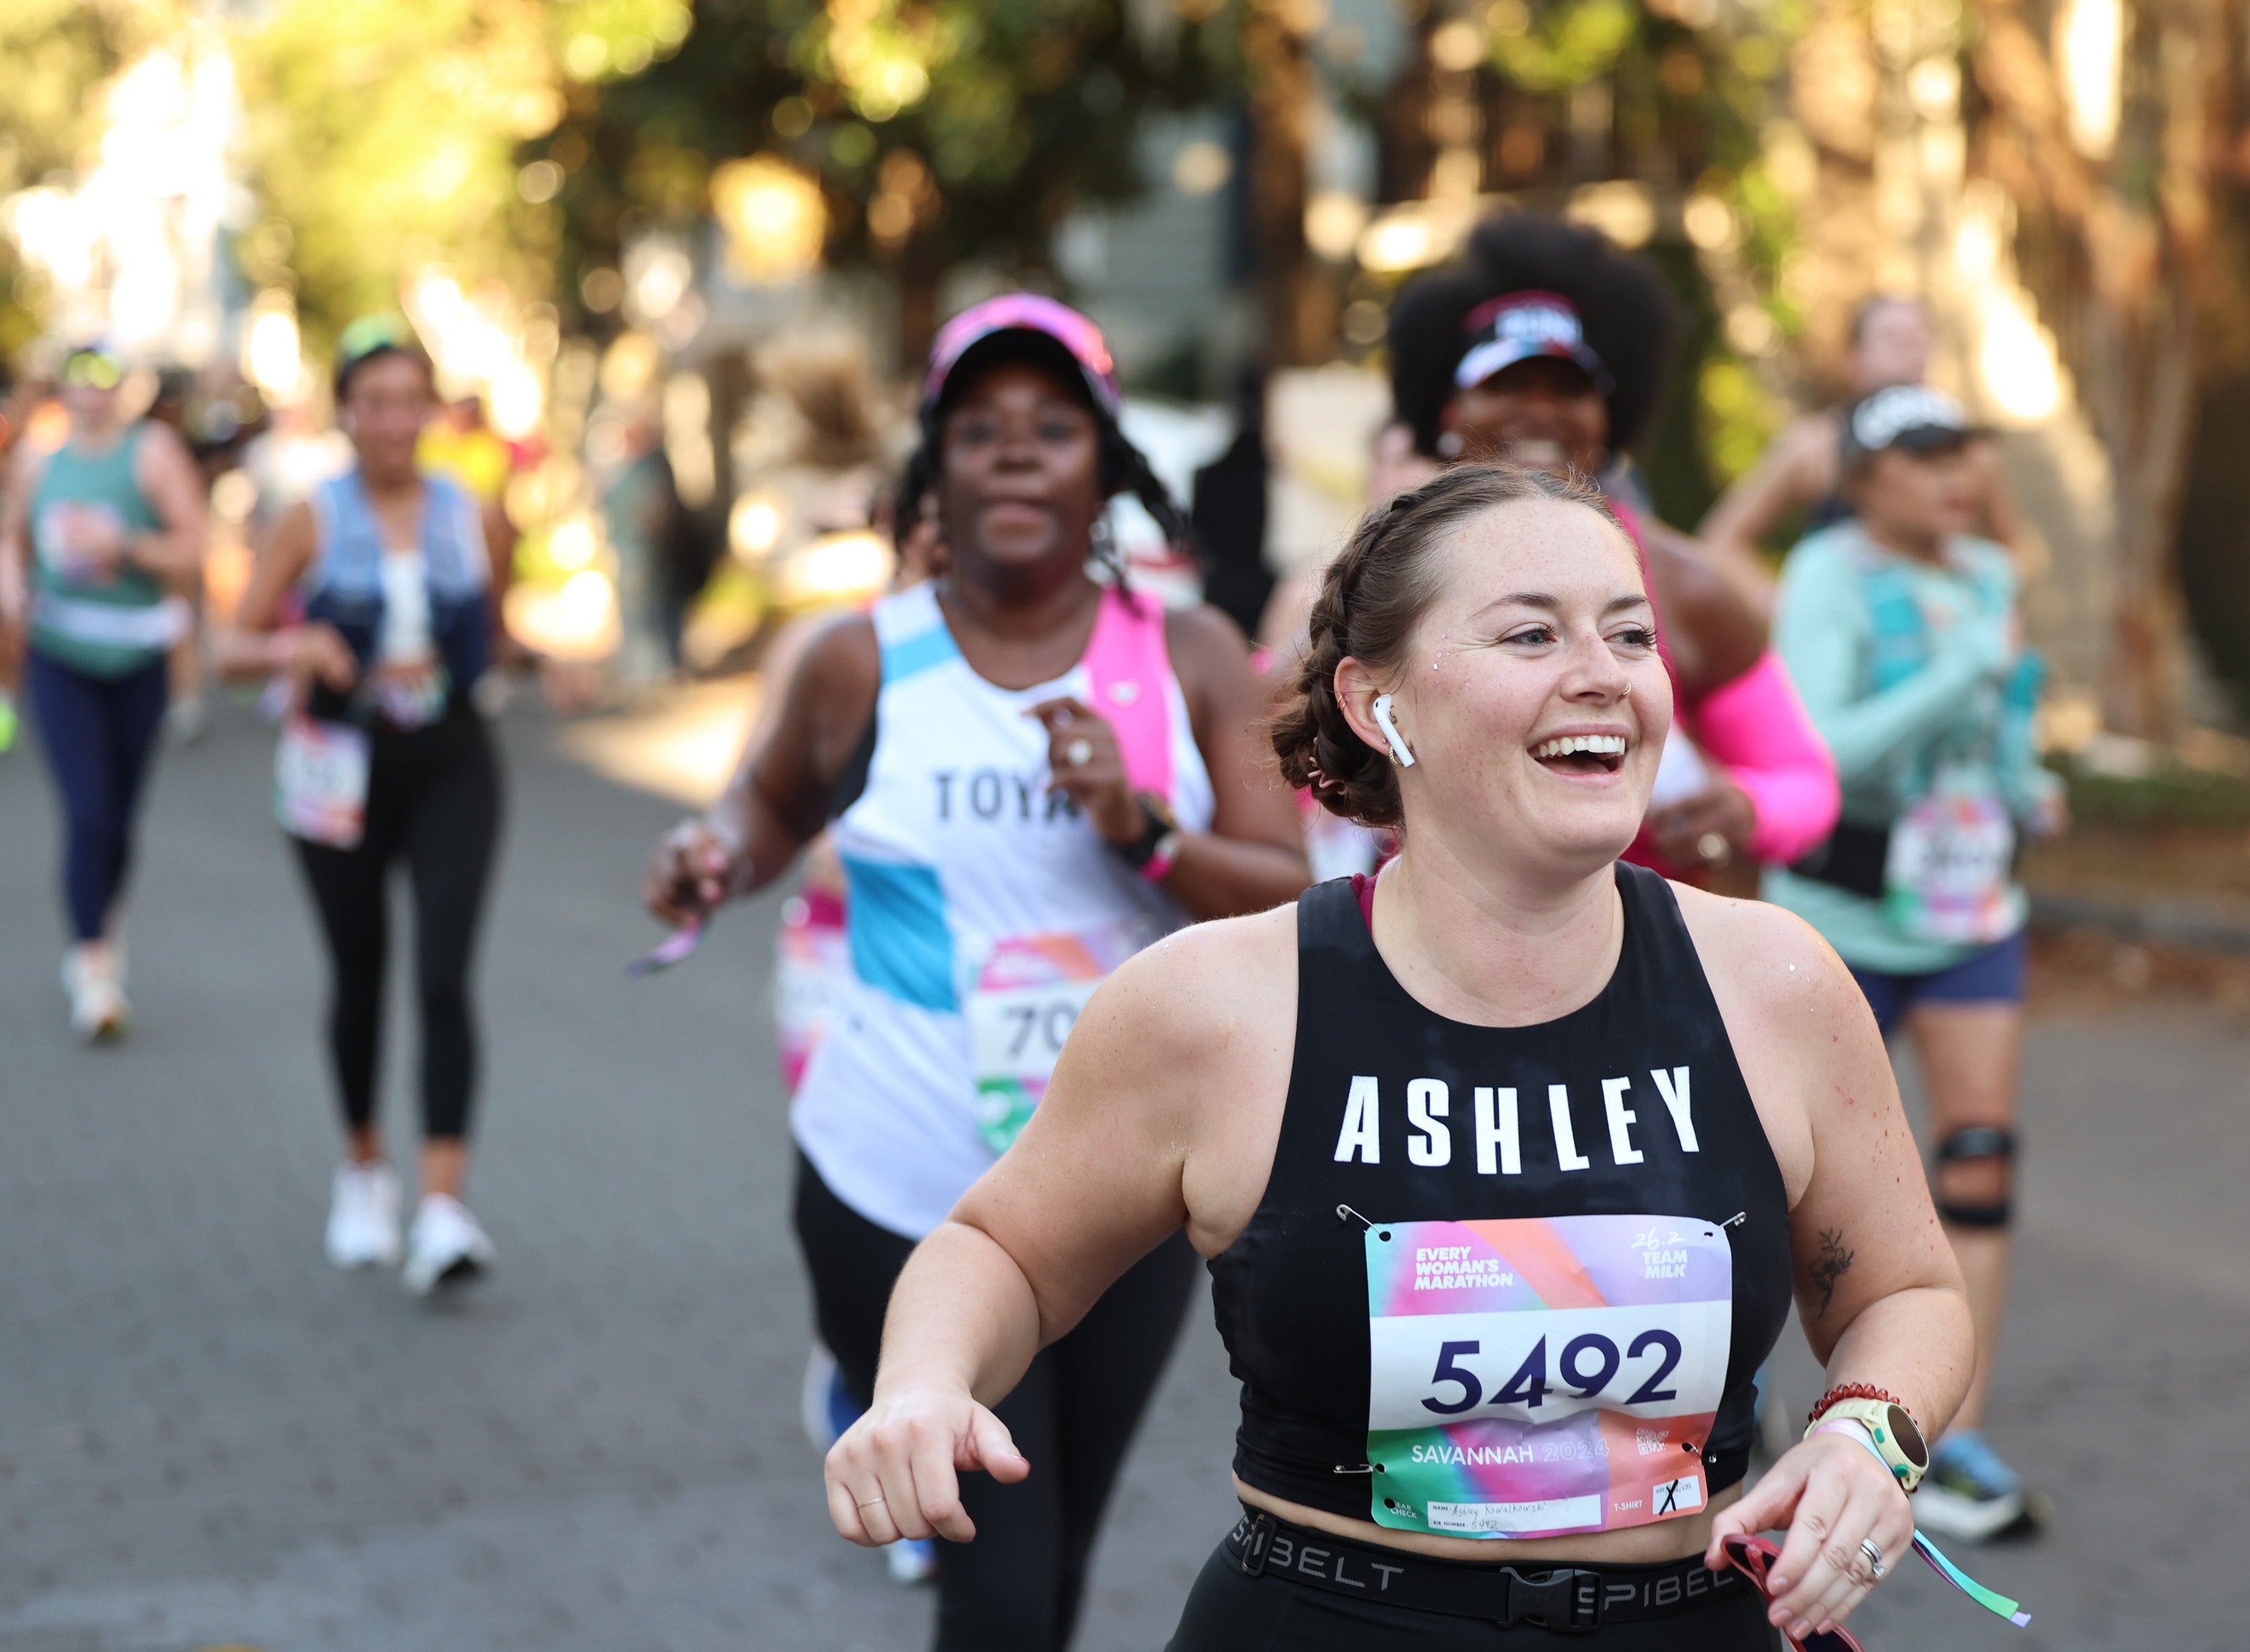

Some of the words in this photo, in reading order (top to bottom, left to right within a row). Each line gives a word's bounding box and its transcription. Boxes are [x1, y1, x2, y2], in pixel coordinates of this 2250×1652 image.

[1334, 1065, 1700, 1174] ASHLEY
[1630, 1226, 1686, 1251] 26.2
[1416, 1246, 1472, 1262] EVERY
[1642, 1249, 1689, 1265] TEAM
[1416, 1259, 1500, 1276] WOMAN'S
[1644, 1263, 1687, 1279] MILK
[1414, 1272, 1514, 1290] MARATHON
[1421, 1329, 1682, 1414] 5492
[1412, 1444, 1534, 1465] SAVANNAH
[1542, 1438, 1609, 1463] 2024
[1390, 1507, 1418, 1520] CHECK
[1452, 1504, 1479, 1520] Ashley
[1613, 1500, 1643, 1511] T-SHIRT
[1472, 1520, 1499, 1531] 5492
